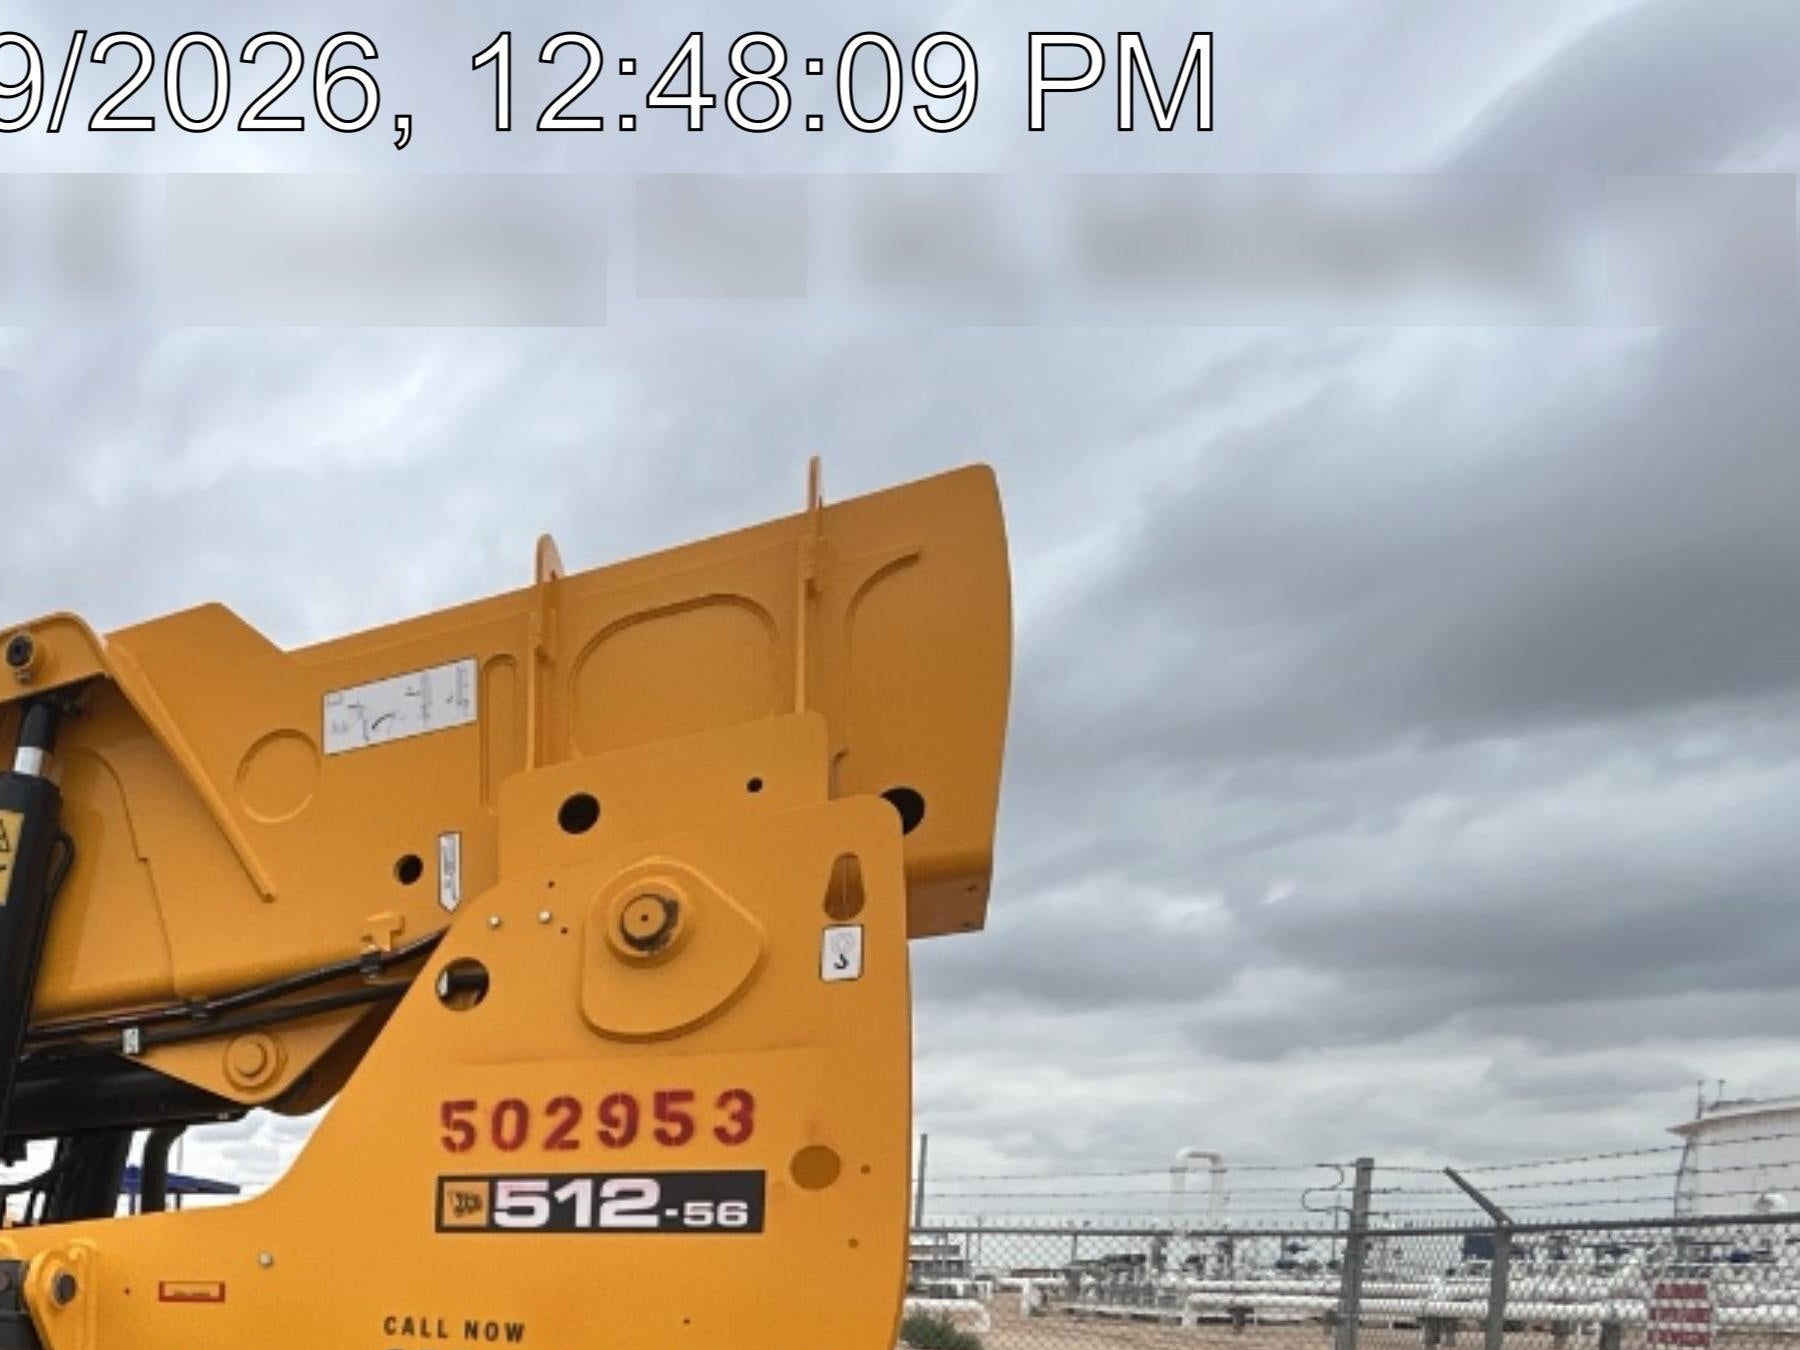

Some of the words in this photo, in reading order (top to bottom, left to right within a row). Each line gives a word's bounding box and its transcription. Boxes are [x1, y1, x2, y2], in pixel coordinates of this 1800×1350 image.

[440, 1087, 756, 1154] 502953
[493, 1177, 749, 1229] 512-56
[383, 1316, 449, 1340] CALL
[463, 1320, 526, 1343] NOW
